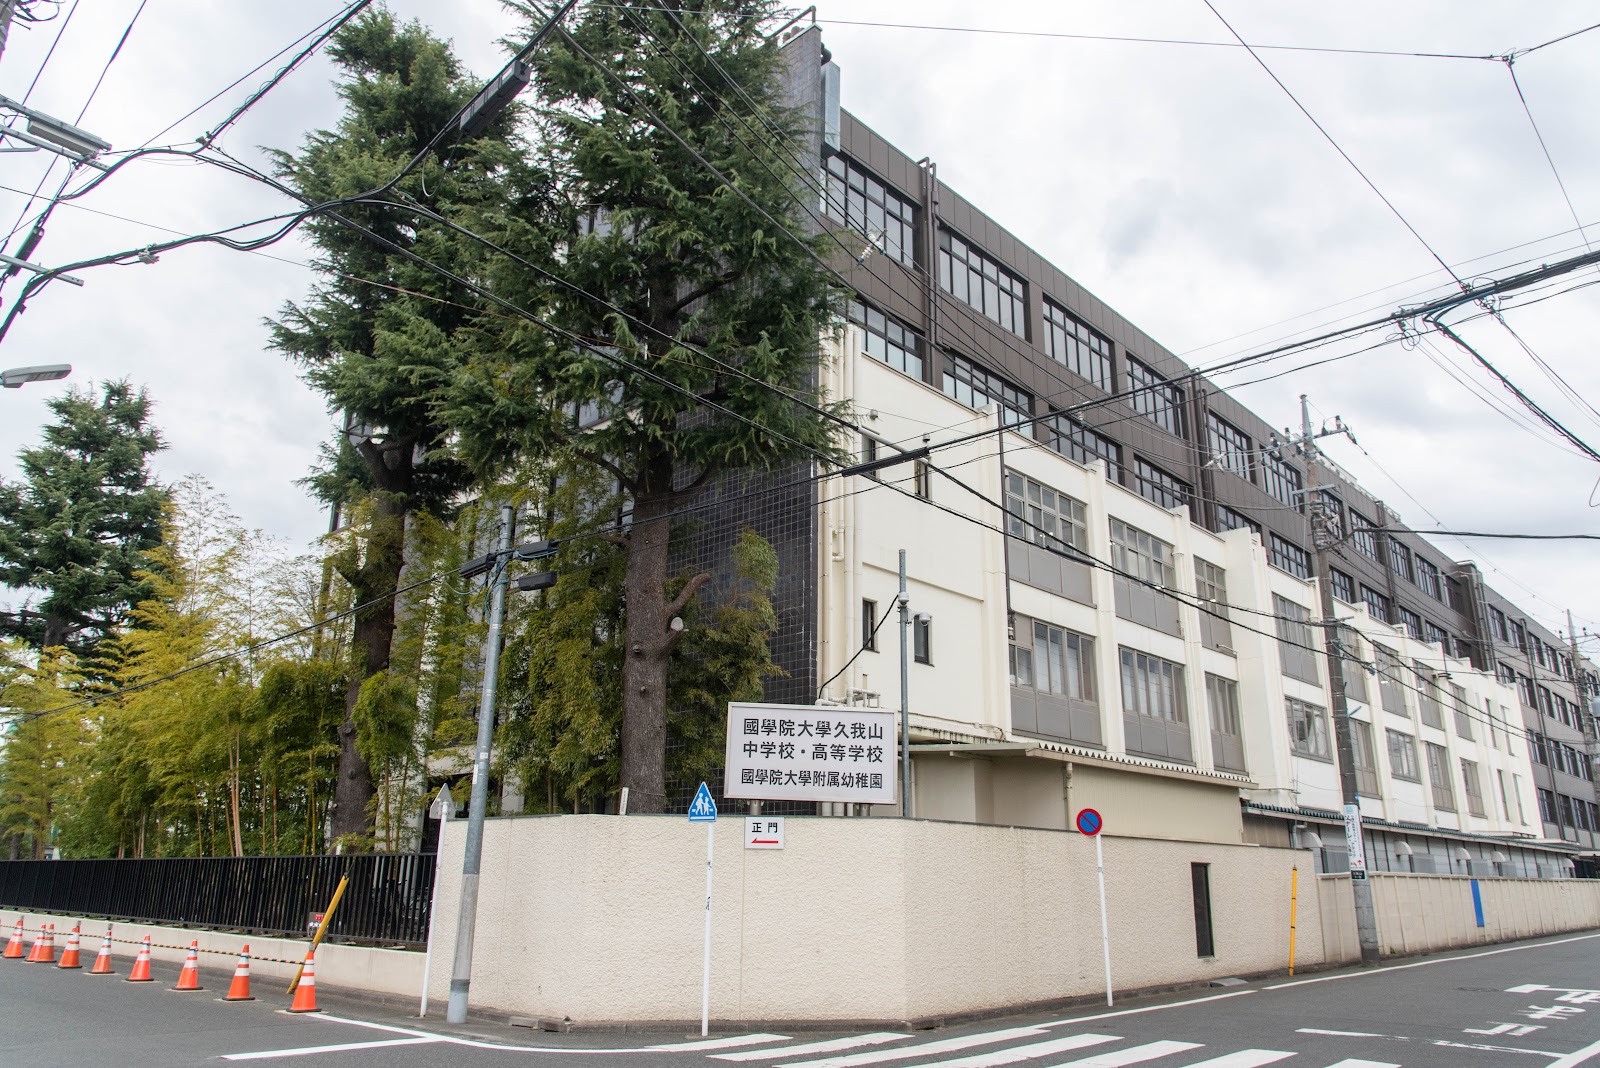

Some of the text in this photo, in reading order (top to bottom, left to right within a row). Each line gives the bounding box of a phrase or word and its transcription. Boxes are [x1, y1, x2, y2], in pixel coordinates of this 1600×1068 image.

[743, 718, 883, 740] 國學院大學久我山
[743, 741, 883, 763] 中学校・高等学校
[741, 768, 883, 789] 國學院大學附属幼稚園
[751, 822, 778, 833] 正門
